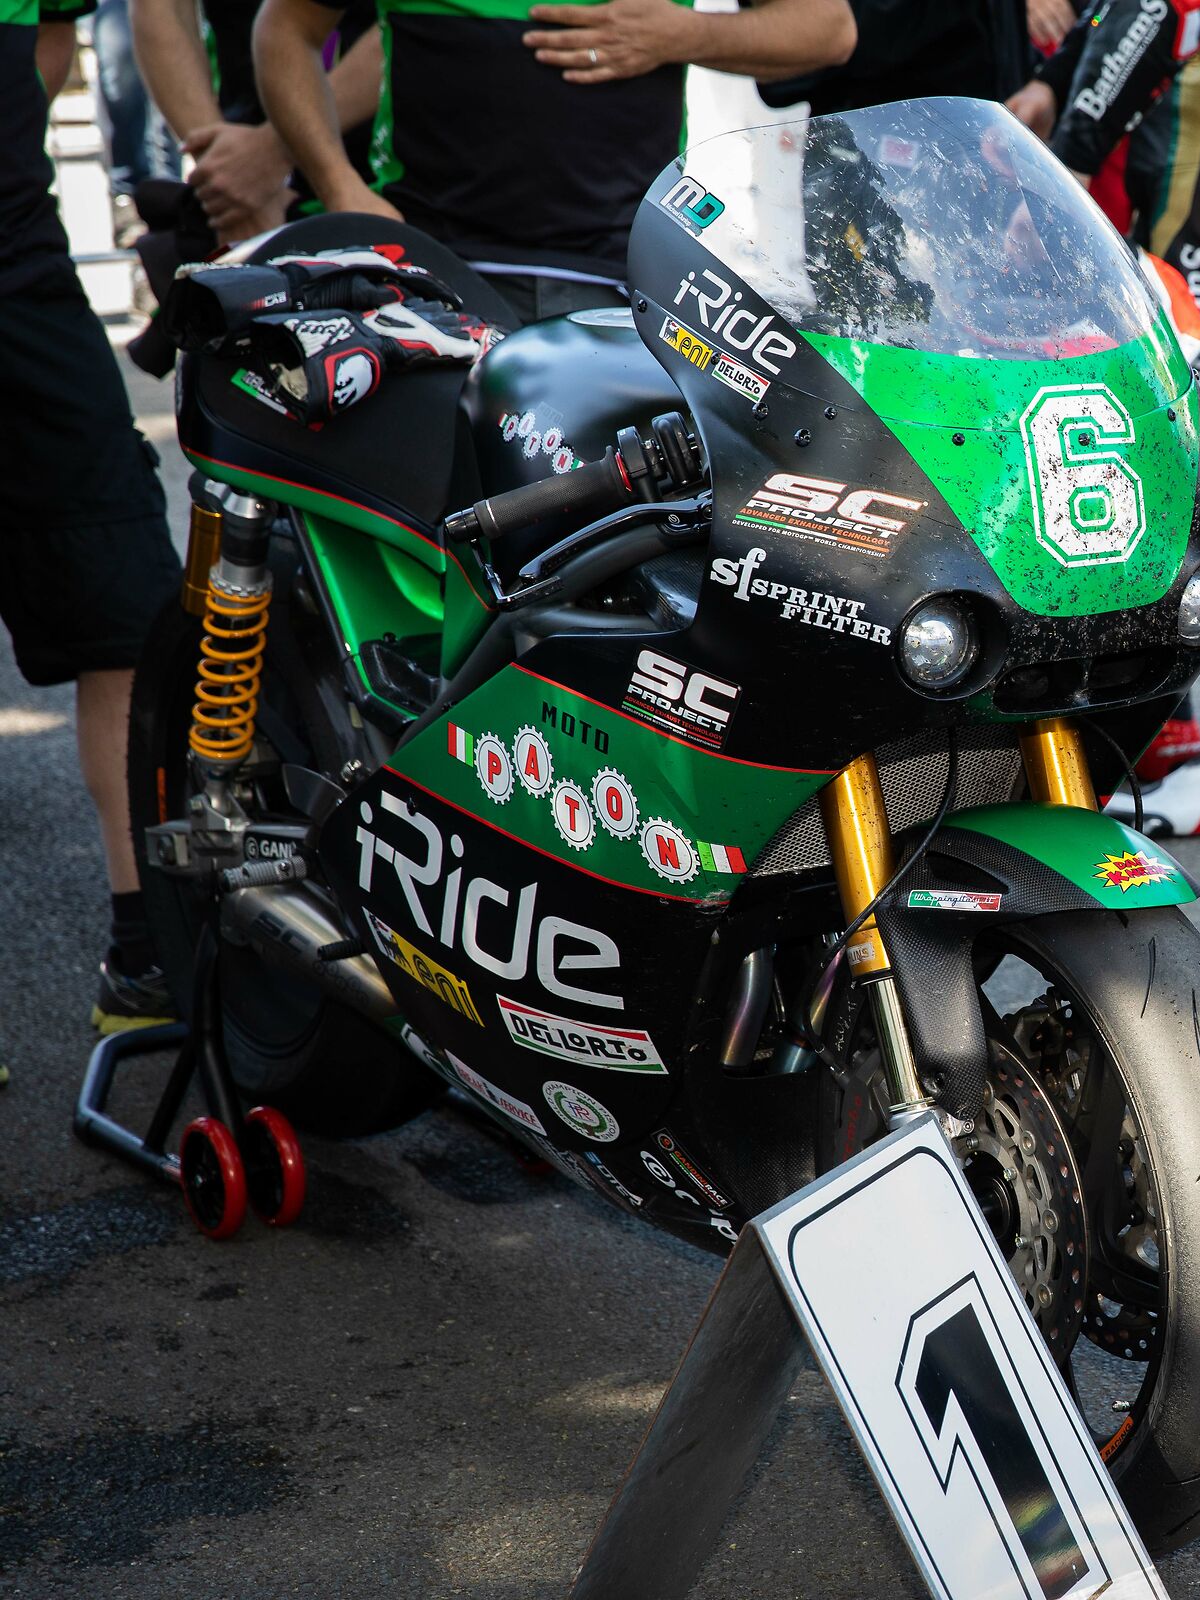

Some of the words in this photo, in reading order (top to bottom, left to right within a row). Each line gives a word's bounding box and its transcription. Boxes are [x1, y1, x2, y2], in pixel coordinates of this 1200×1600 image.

[678, 335, 713, 371] eni
[1020, 383, 1147, 568] 6
[739, 507, 787, 522] ADVANCED
[787, 518, 830, 533] EXHAUST
[831, 527, 891, 546] TECHNOLOGY
[746, 498, 899, 539] PROJECT
[752, 473, 924, 533] SC
[731, 518, 768, 532] DEVELOPED
[767, 526, 782, 536] FOR
[813, 536, 837, 548] WORLD
[837, 541, 886, 559] CHAMPIONSHIP
[750, 578, 866, 619] SPRINT
[779, 601, 892, 646] FILTER
[627, 683, 727, 732] PROJECT
[631, 649, 738, 723] SC
[541, 700, 611, 755] MOTO
[485, 742, 684, 872] PATON
[512, 1011, 648, 1064] DELLORTO
[894, 1270, 1112, 1600] 1
